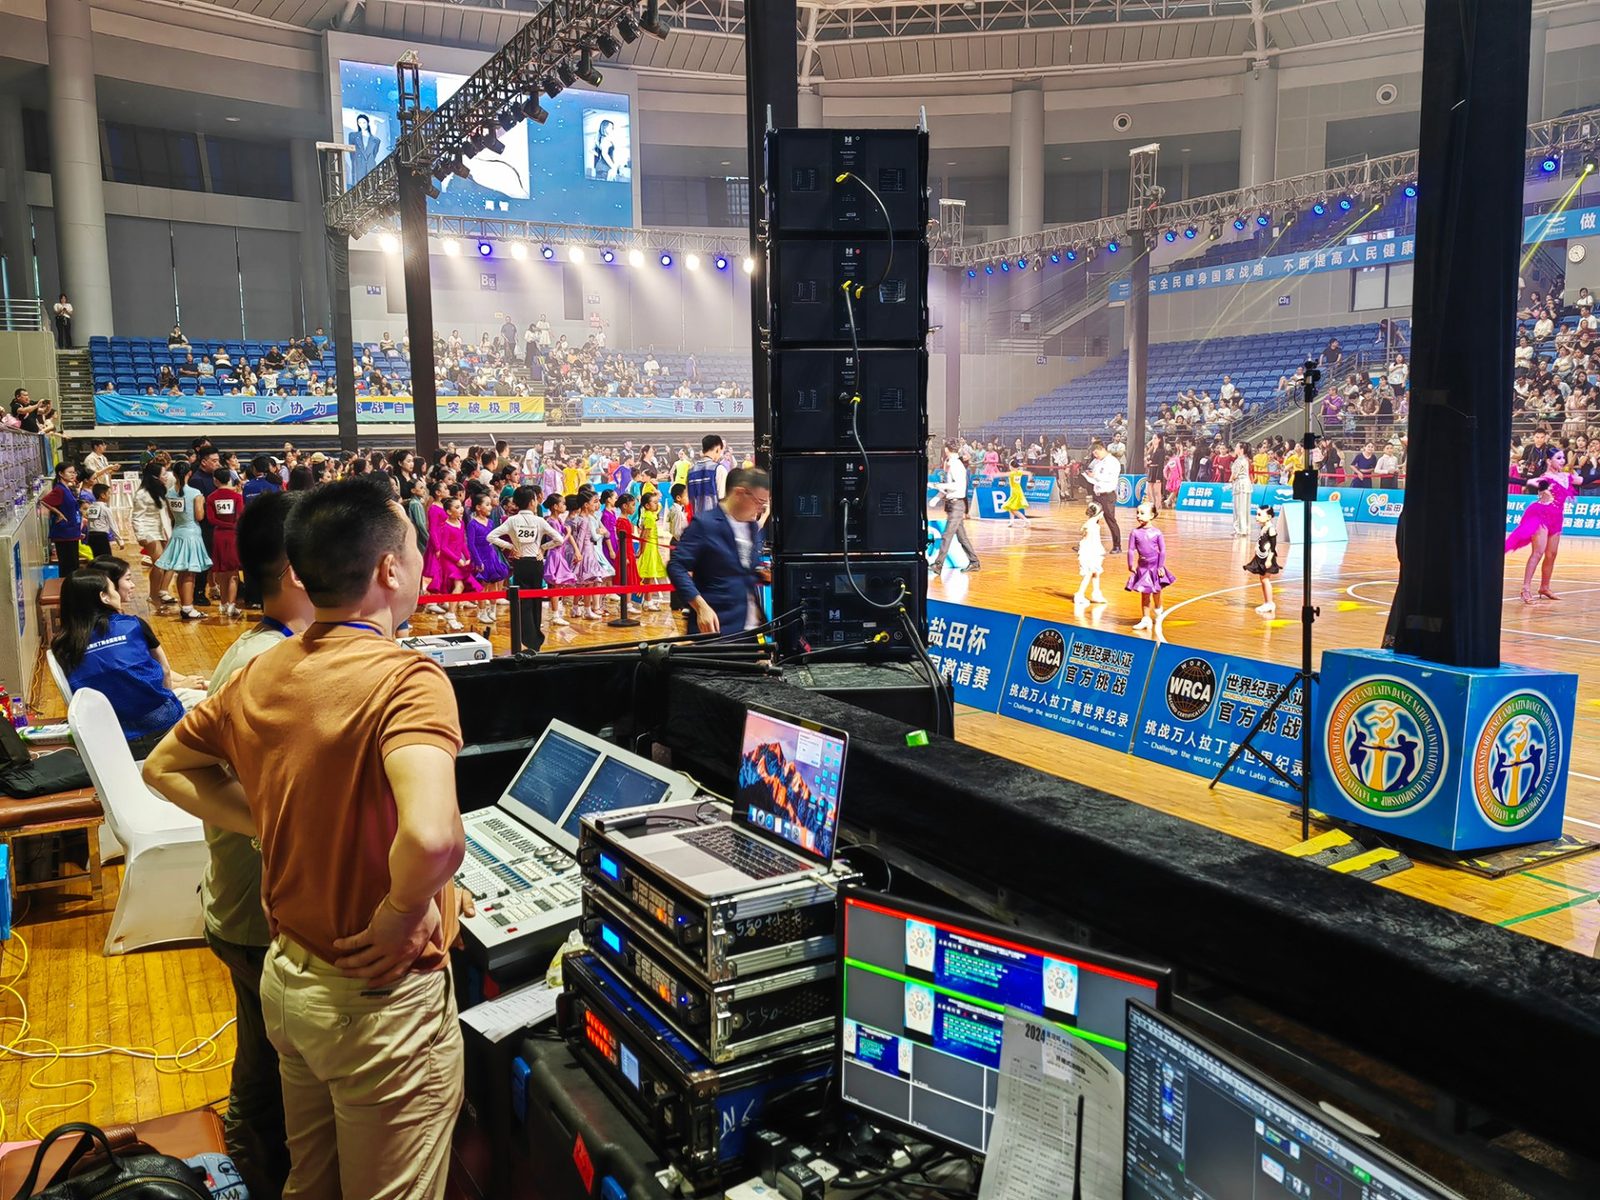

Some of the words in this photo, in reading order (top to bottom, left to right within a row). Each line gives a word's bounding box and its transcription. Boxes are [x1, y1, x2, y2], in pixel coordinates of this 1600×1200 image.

[1580, 212, 1597, 231] 做
[242, 401, 328, 416] 同心协力
[447, 401, 521, 414] 突破极限
[673, 400, 745, 413] 青春飞扬
[216, 503, 231, 511] 541
[992, 490, 1007, 513] B
[518, 529, 535, 538] 284
[928, 616, 990, 656] 盐田杯
[1030, 645, 1061, 668] WRCA
[1072, 641, 1135, 669] 世界纪录认证
[1181, 660, 1211, 675] WORLD
[1065, 664, 1128, 697] 官方挑战
[1170, 676, 1211, 703] WRCA
[1008, 682, 1129, 728] 挑战万人拉丁舞世界纪录
[1342, 691, 1362, 712] DANCE
[1391, 687, 1413, 705] DANCE
[1013, 701, 1034, 714] Challenge
[1035, 708, 1044, 717] the
[1044, 711, 1059, 720] world
[1076, 719, 1085, 728] for
[1086, 723, 1099, 733] Latin
[1100, 727, 1116, 737] dance
[1218, 701, 1303, 740] 官方挑战
[1332, 708, 1347, 742] STANDARD
[1410, 699, 1435, 734] NATIONAL
[1151, 741, 1179, 756] Challenge
[1180, 749, 1191, 760] the
[1193, 755, 1211, 765] world
[1212, 760, 1234, 772] recd
[1236, 766, 1247, 776] for
[1250, 770, 1266, 782] Latin
[1268, 776, 1290, 788] dance
[1421, 733, 1438, 785] INVITATIONAL
[1380, 779, 1427, 805] CHAMPIONSHIP
[1025, 1023, 1046, 1043] 2024
